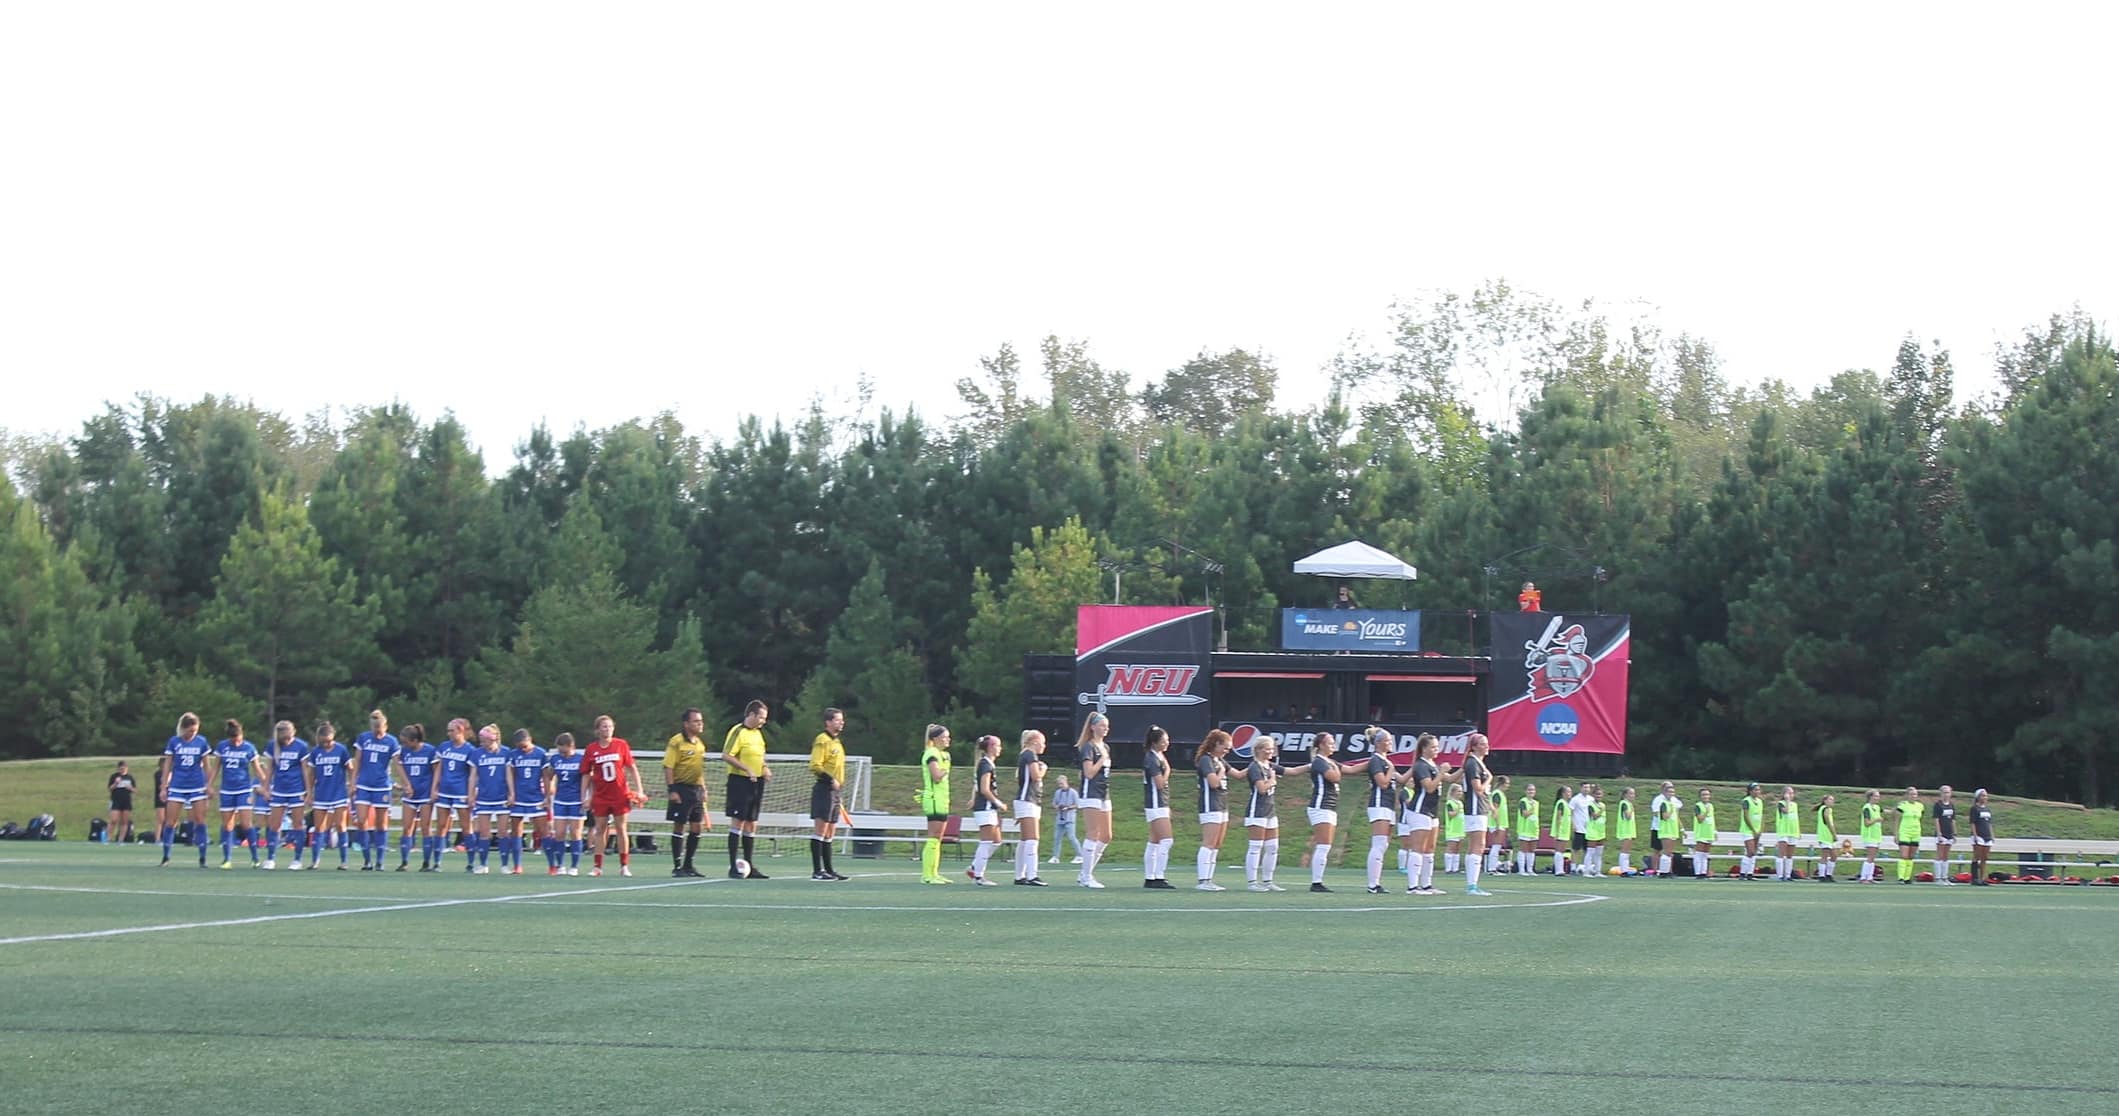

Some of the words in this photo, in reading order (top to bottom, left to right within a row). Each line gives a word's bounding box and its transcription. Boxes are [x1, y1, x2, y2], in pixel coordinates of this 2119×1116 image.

[1304, 624, 1339, 634] MAKE
[1358, 617, 1407, 640] YOURS
[1104, 664, 1200, 696] NGU
[1540, 722, 1577, 735] NCAA
[1268, 732, 1344, 752] PEPI
[323, 764, 334, 776] 12
[448, 760, 456, 771] 9
[487, 765, 497, 777] 7
[601, 761, 616, 782] 0
[560, 770, 569, 781] 2
